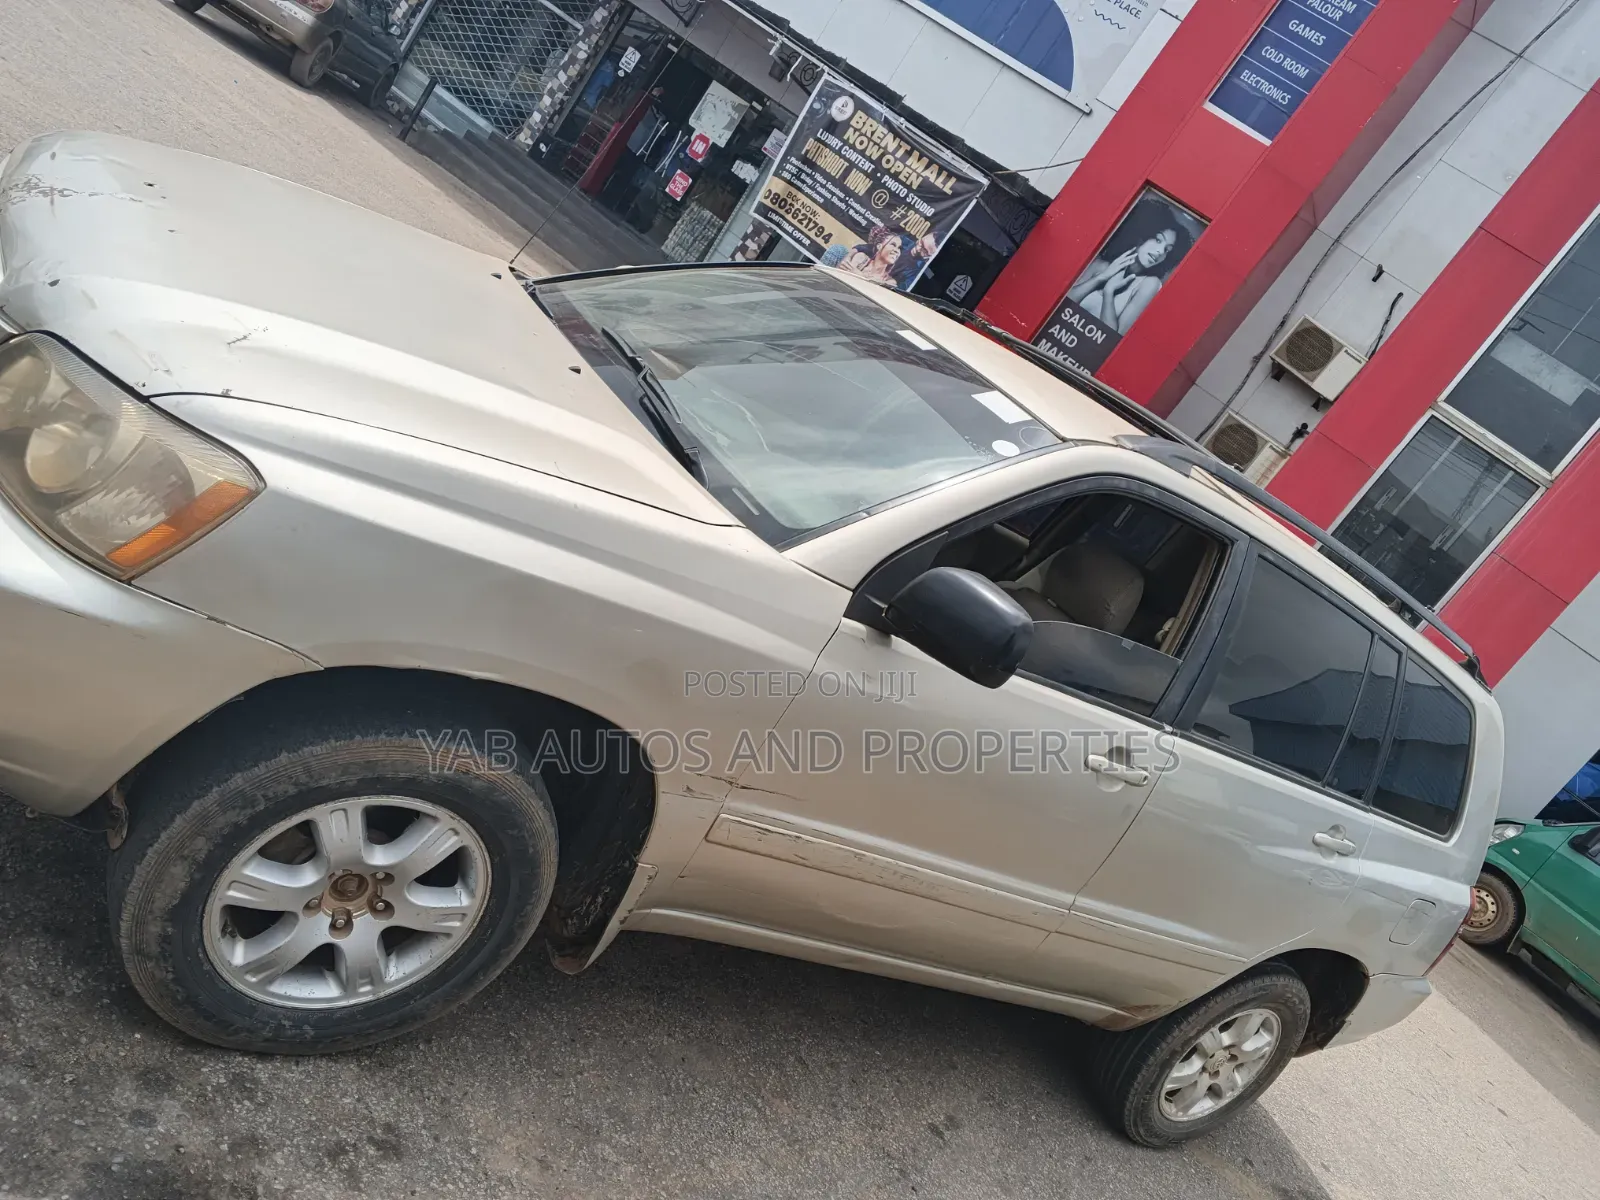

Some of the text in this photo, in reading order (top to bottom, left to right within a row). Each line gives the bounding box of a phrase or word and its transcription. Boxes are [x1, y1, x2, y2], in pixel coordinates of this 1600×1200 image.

[1306, 0, 1343, 21] PALOUR
[1288, 19, 1326, 46] GAMES
[1261, 45, 1310, 79] COLD ROOM
[1239, 69, 1292, 105] ELECTRONICS
[692, 139, 707, 154] IN
[843, 127, 924, 190] NOW OPEN
[849, 110, 957, 195] BRENT MALL
[669, 183, 684, 196] GLASS
[674, 175, 688, 187] MIND
[674, 180, 683, 189] THE
[841, 145, 875, 173] CONTENT
[881, 175, 908, 197] PHOTO
[906, 192, 935, 217] STUDIO
[843, 168, 873, 197] NOW
[871, 189, 889, 208] @
[799, 201, 820, 220] NOW:
[792, 228, 811, 246] OFFER
[1048, 324, 1078, 348] AND
[1061, 307, 1107, 344] SALON
